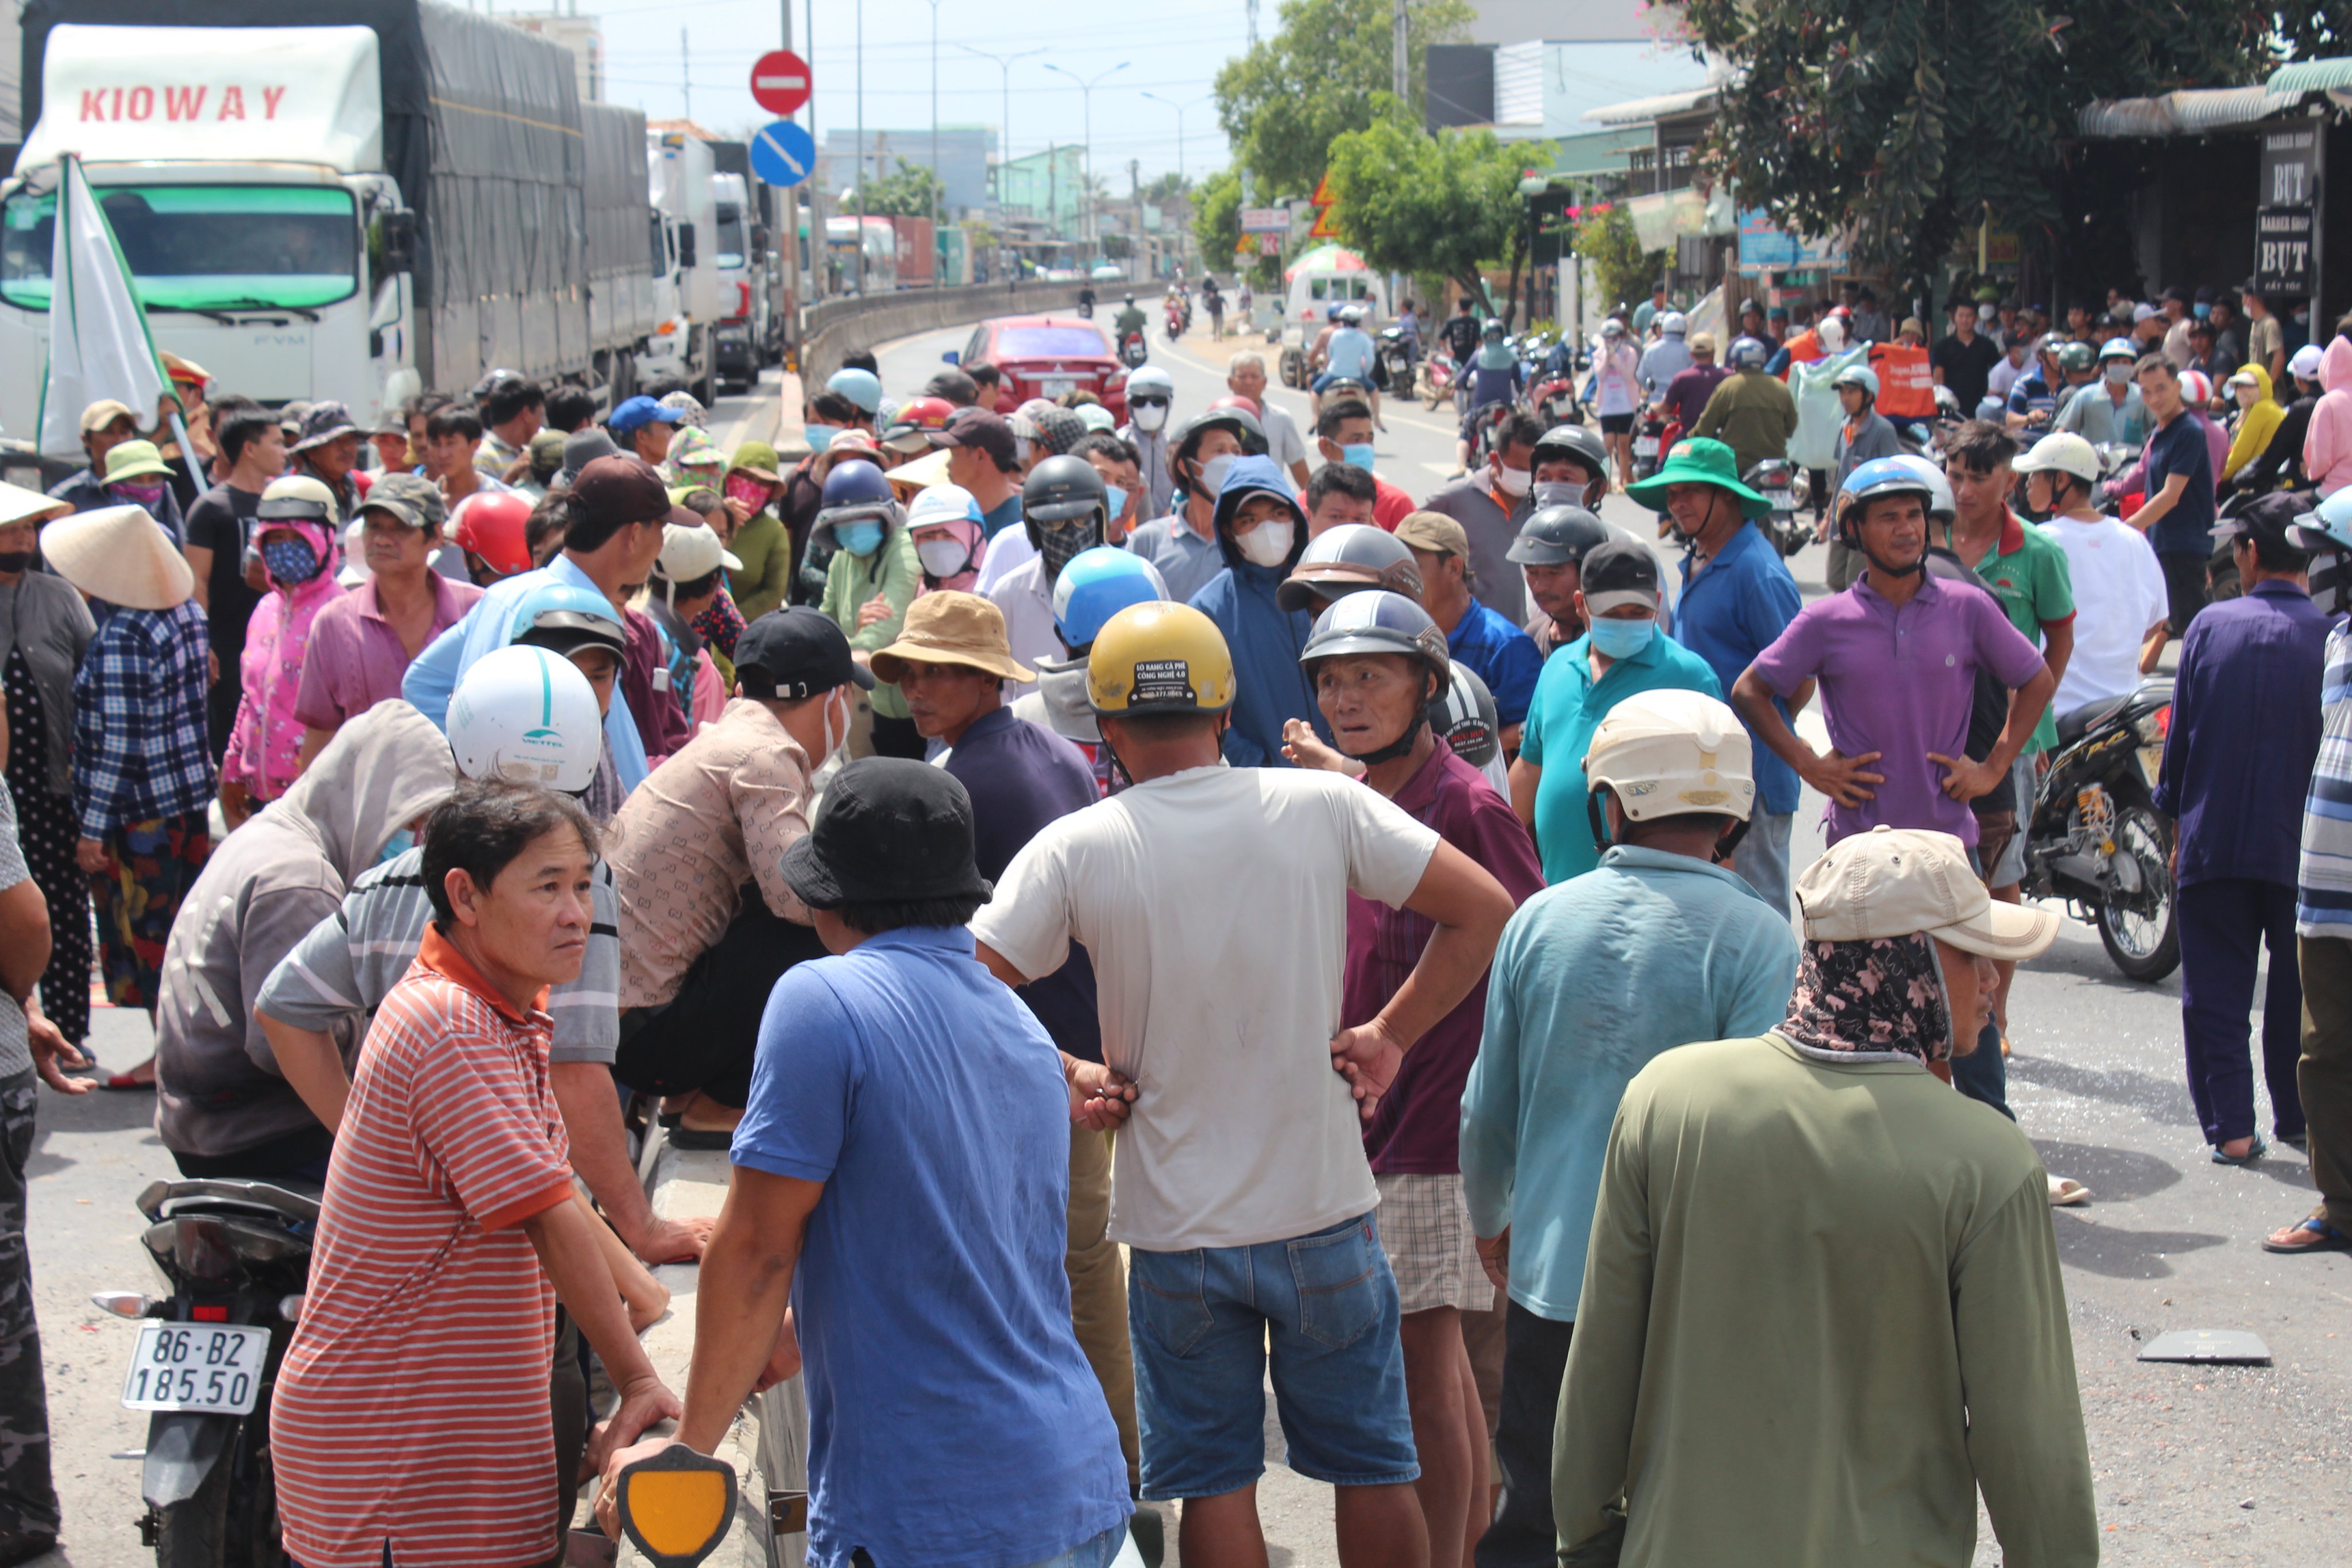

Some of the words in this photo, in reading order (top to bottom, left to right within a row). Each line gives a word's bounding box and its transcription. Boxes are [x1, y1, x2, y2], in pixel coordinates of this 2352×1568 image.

[2266, 134, 2294, 150] BARBER
[2295, 132, 2314, 148] SHOP
[2261, 215, 2290, 231] BARBER
[2291, 216, 2310, 231] SHOP
[2261, 242, 2307, 277] BỤT
[153, 1330, 245, 1367] 86-B2
[137, 1369, 250, 1406] 185.50
